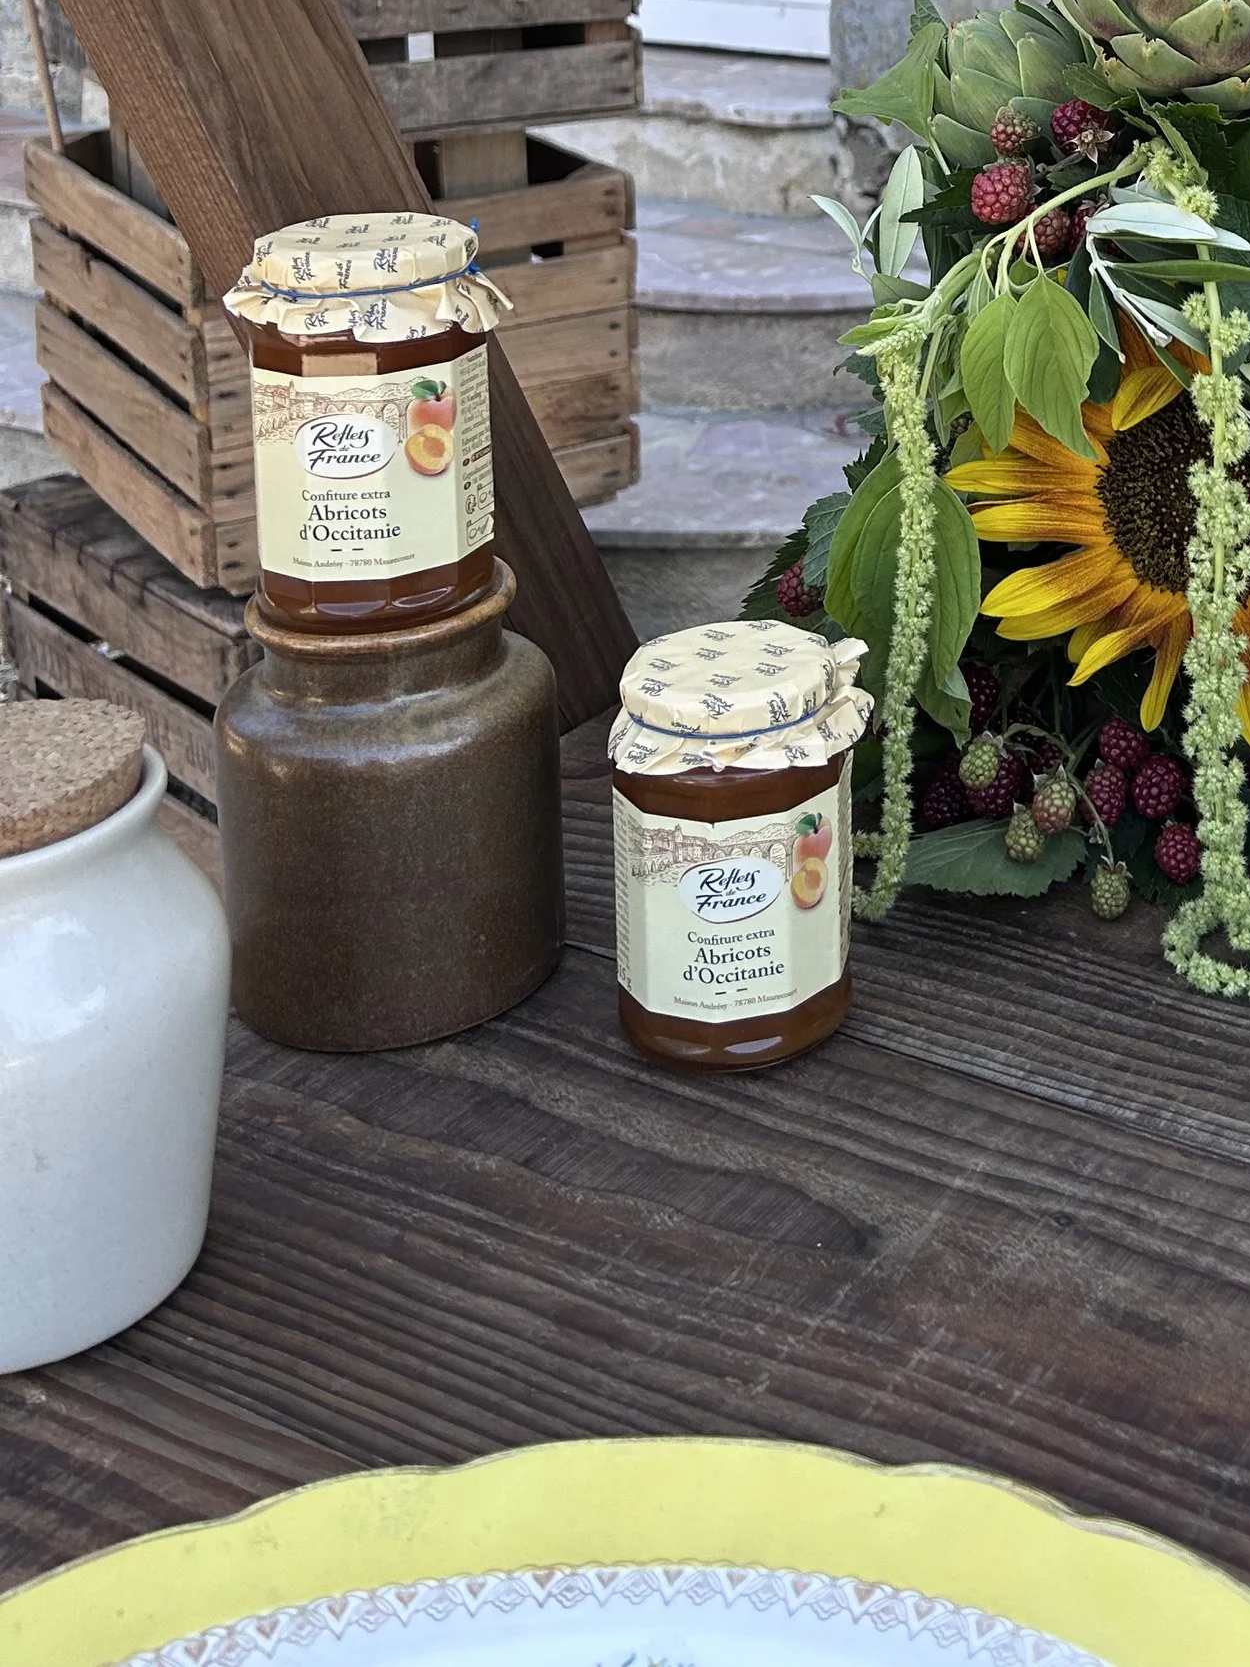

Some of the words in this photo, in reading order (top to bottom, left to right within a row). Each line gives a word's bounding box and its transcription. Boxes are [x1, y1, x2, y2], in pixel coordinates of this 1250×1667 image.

[310, 422, 375, 448] Reflets
[308, 449, 381, 470] France
[302, 490, 358, 502] Confiture
[361, 490, 391, 500] extra
[308, 504, 387, 521] Abricots
[299, 523, 401, 541] d'Occitanie
[698, 868, 760, 893] Reflets
[696, 893, 767, 914] France
[687, 931, 743, 945] Confiture
[746, 929, 775, 940] extra
[694, 946, 771, 965] Abricots
[683, 961, 785, 984] d'Occitanie
